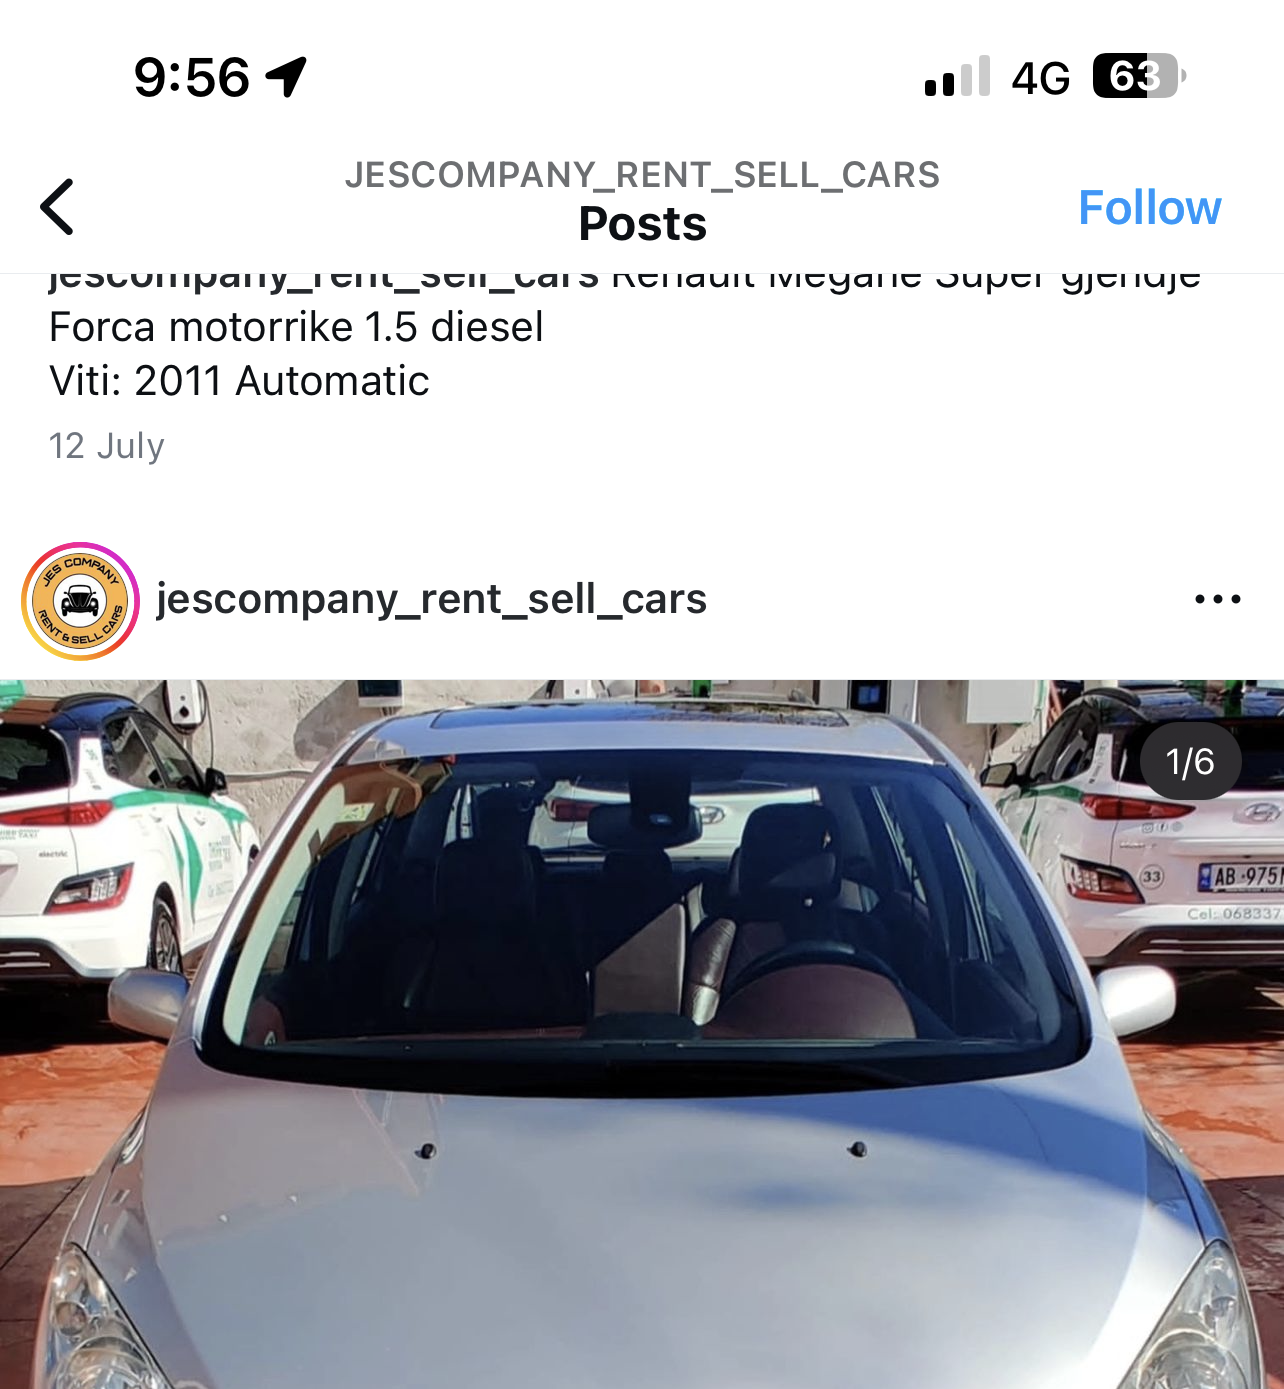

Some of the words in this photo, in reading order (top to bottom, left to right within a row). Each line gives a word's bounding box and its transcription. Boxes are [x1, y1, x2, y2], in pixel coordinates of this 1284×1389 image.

[135, 57, 249, 97] 9:56
[1012, 61, 1069, 95] 4G
[1110, 60, 1160, 91] 63
[345, 161, 939, 193] JESCOMPANY_RENT_SELL_CARS
[1081, 188, 1222, 225] Follow
[581, 206, 706, 241] Posts
[52, 311, 153, 342] Forca
[171, 310, 352, 342] motorrike
[366, 311, 417, 342] 1.5
[432, 310, 541, 342] diesel
[49, 364, 119, 395] Viti:
[136, 364, 221, 396] 2011
[235, 364, 429, 396] Automatic
[50, 432, 84, 458] 12
[98, 431, 164, 465] July
[42, 564, 62, 587] JES
[64, 557, 120, 585] COMPANY
[156, 581, 706, 621] jescompany_rent_sell_cars
[38, 609, 62, 637] RENT
[62, 633, 69, 642] &
[71, 633, 103, 644] SELL
[102, 605, 123, 634] CARS
[1143, 871, 1161, 883] 33
[1215, 867, 1236, 886] AB
